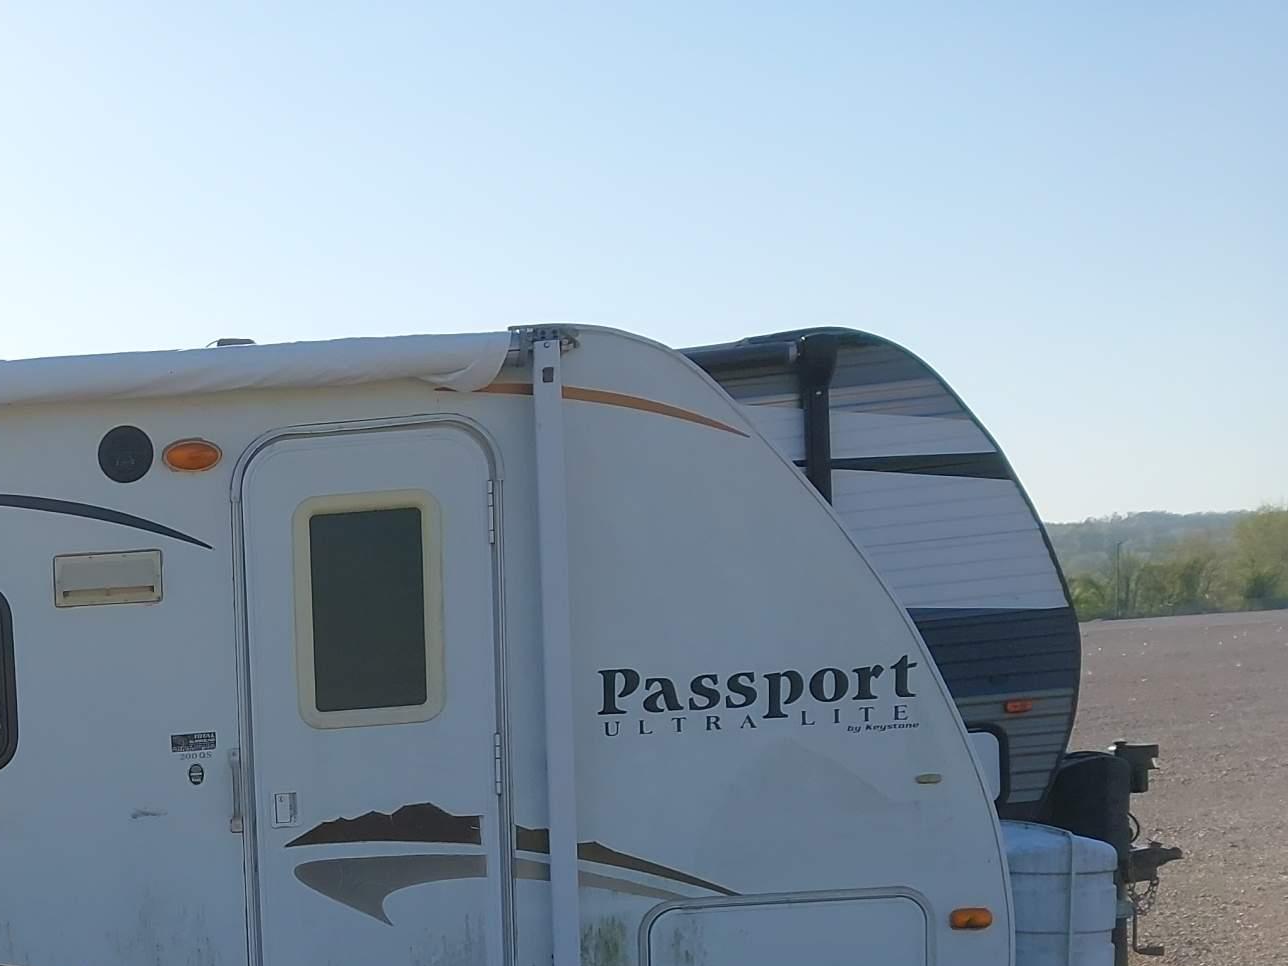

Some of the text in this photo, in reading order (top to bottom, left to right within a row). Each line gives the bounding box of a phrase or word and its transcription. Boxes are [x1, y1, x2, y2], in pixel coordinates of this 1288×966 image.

[597, 654, 918, 719] Passport
[604, 704, 910, 737] ULTRA LITE
[847, 722, 920, 733] by Keystone
